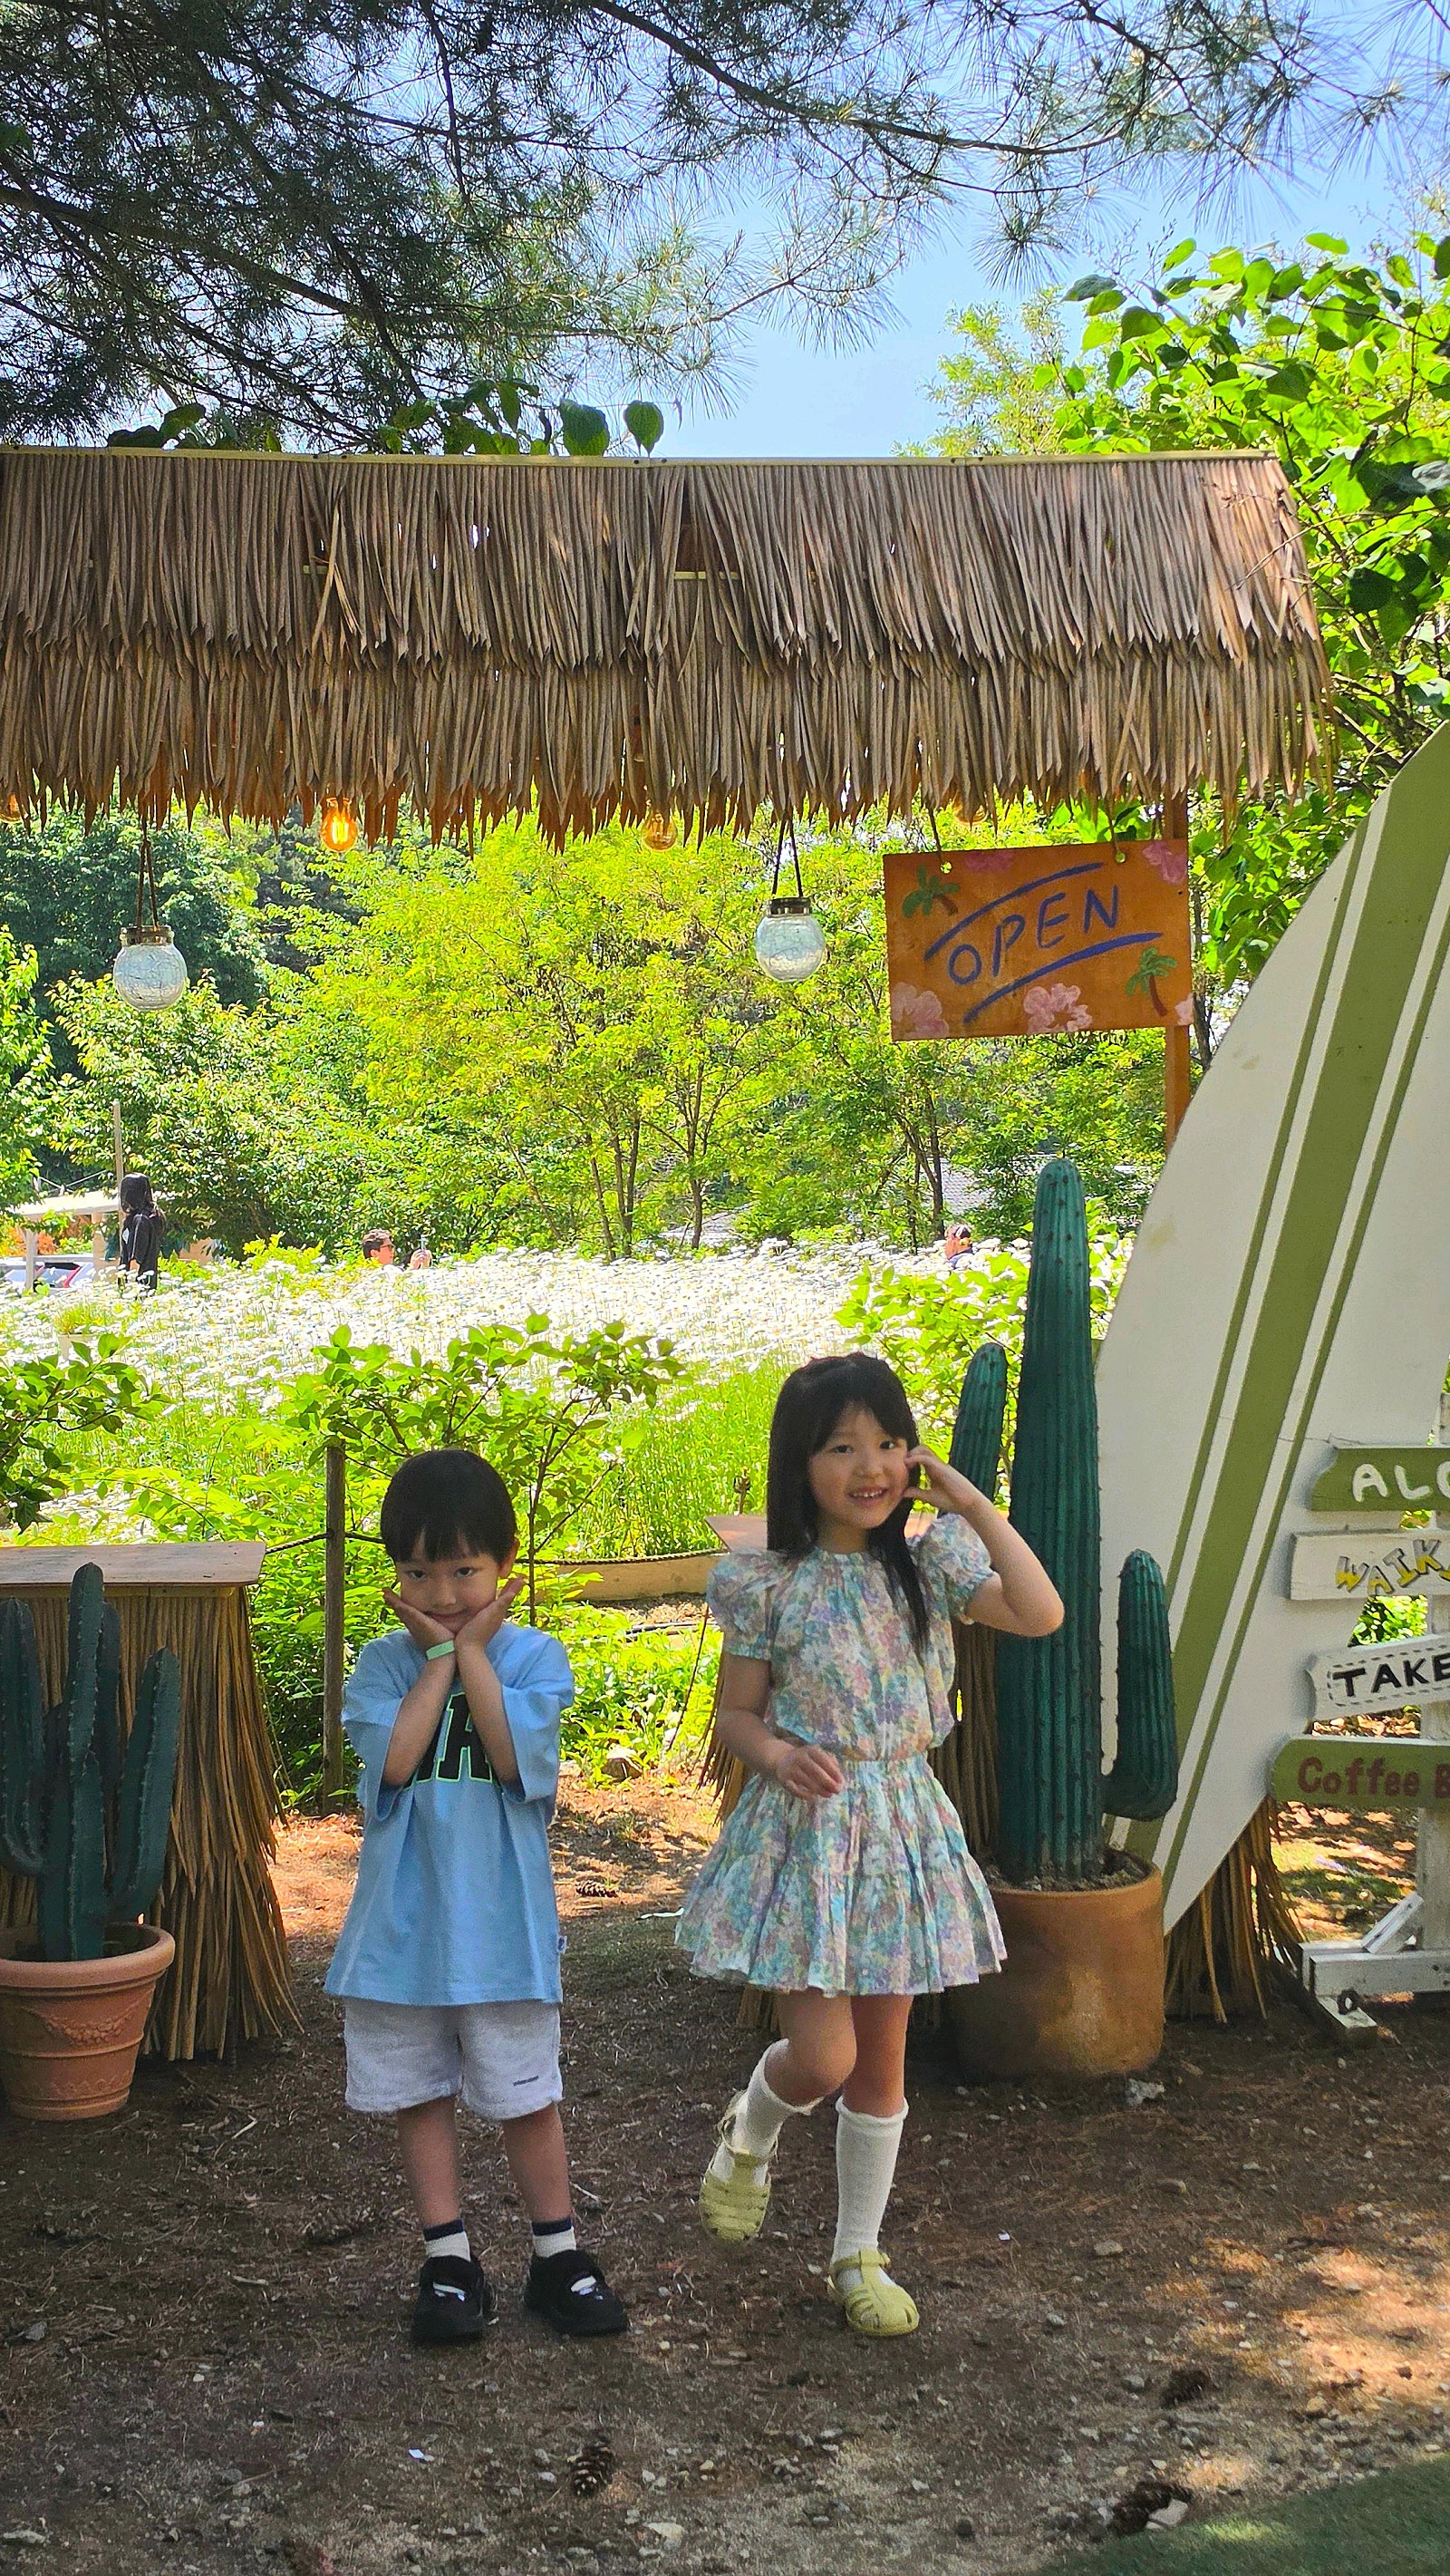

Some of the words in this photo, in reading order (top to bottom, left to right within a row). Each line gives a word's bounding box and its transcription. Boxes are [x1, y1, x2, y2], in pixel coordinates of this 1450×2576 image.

[948, 884, 1119, 986] OPEN
[1331, 1651, 1450, 1698] TAKE
[1297, 1756, 1420, 1797] Coffee
